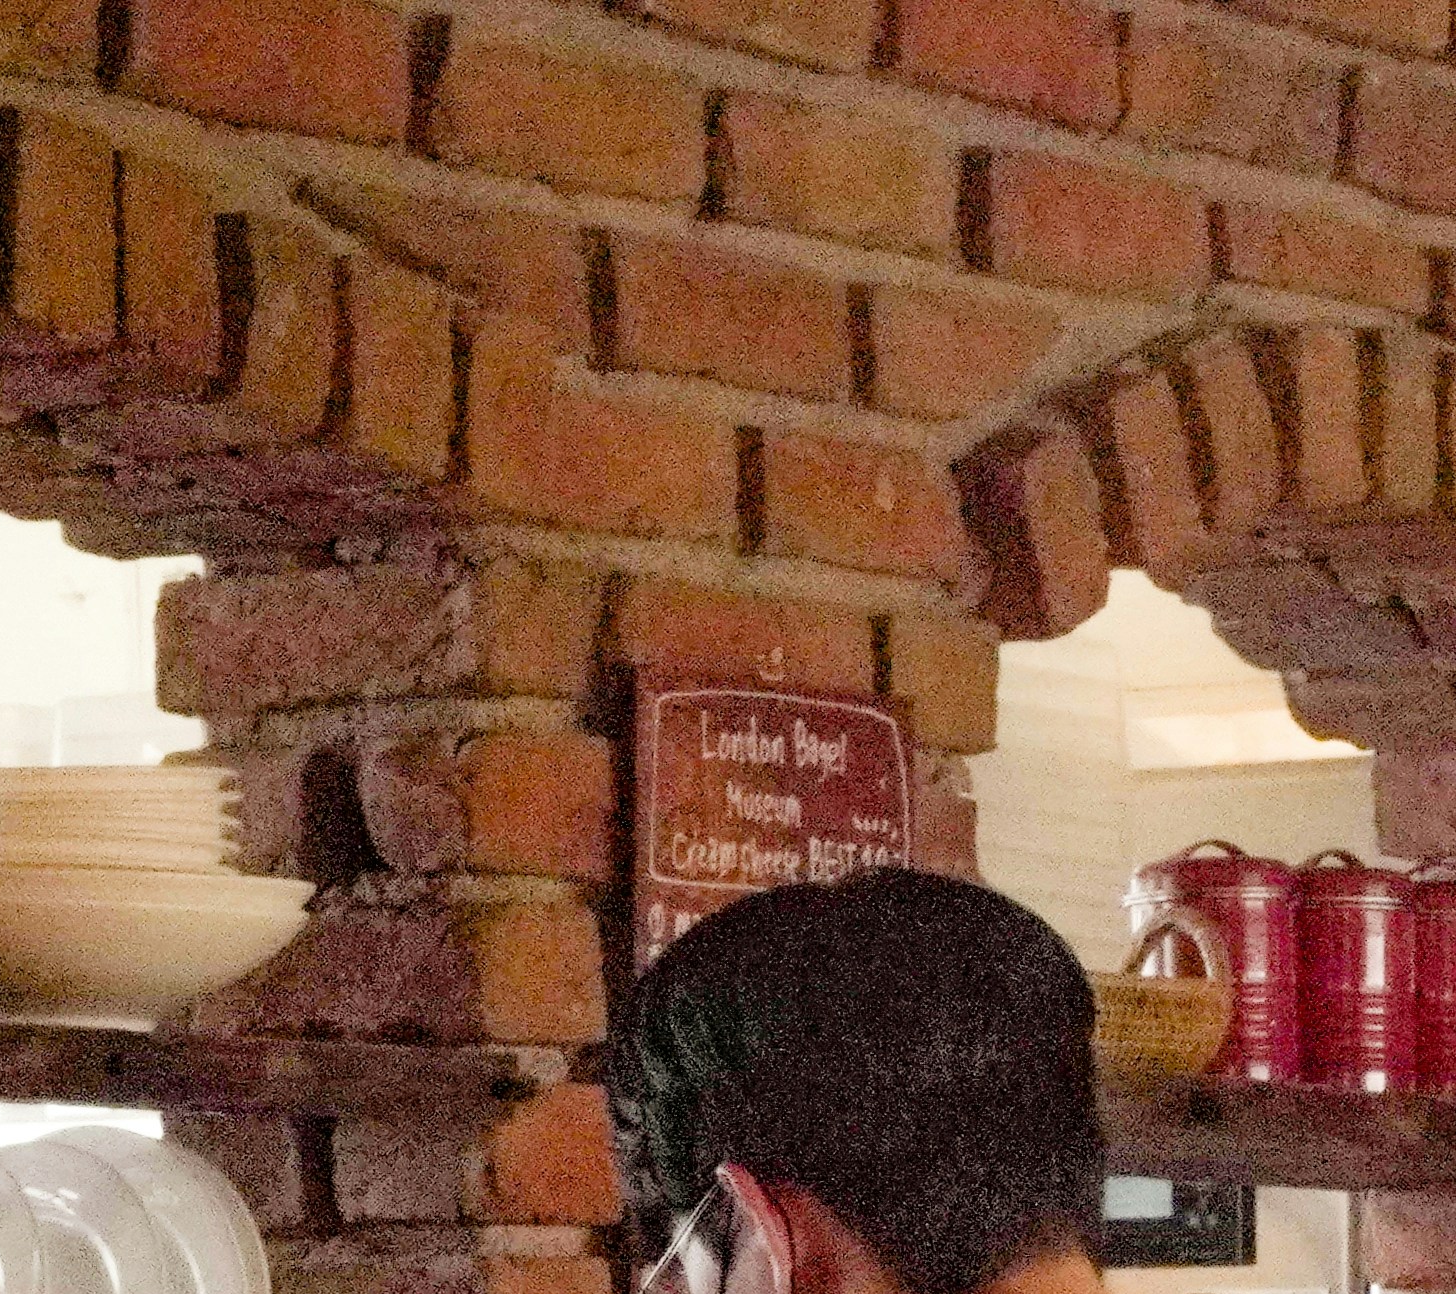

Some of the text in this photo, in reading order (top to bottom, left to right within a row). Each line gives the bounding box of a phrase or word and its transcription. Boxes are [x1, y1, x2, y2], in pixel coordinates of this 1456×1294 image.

[701, 710, 847, 783] London Bagel
[726, 782, 803, 828] Museum
[671, 831, 737, 878] Cream
